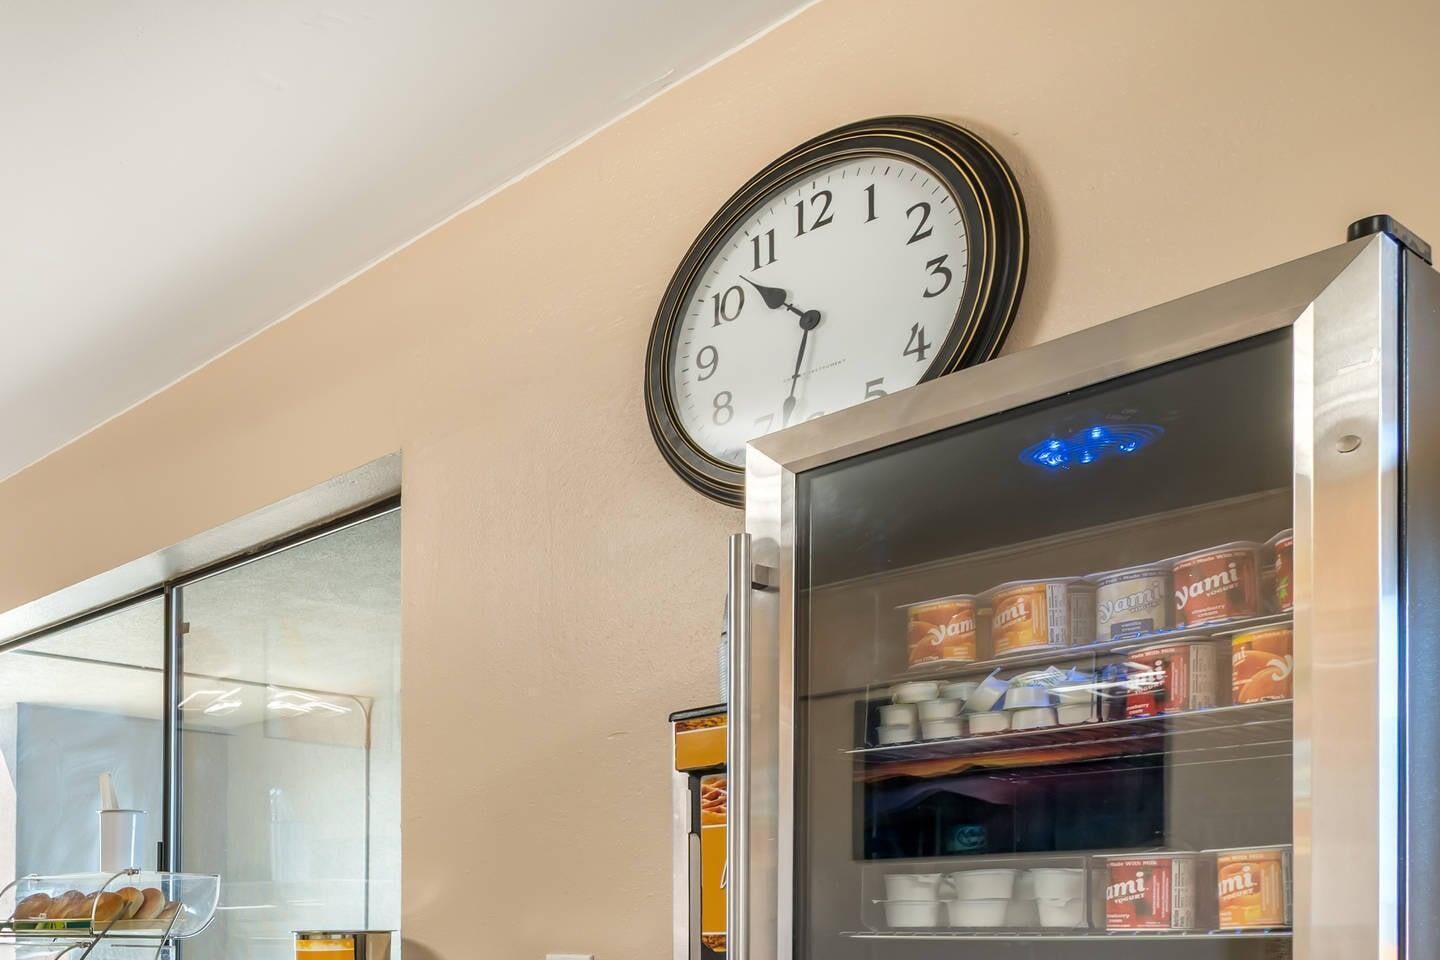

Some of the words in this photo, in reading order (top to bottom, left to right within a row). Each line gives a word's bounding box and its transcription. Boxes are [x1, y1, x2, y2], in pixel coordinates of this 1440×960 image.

[793, 190, 834, 238] 12
[863, 183, 879, 223] 1
[906, 202, 933, 245] 2
[750, 228, 779, 271] 11
[922, 254, 952, 298] 3
[711, 285, 745, 328] 10
[696, 345, 719, 382] 9
[903, 322, 931, 362] 4
[712, 390, 735, 426] 8
[1098, 582, 1161, 624] yami
[1175, 562, 1238, 610] yami
